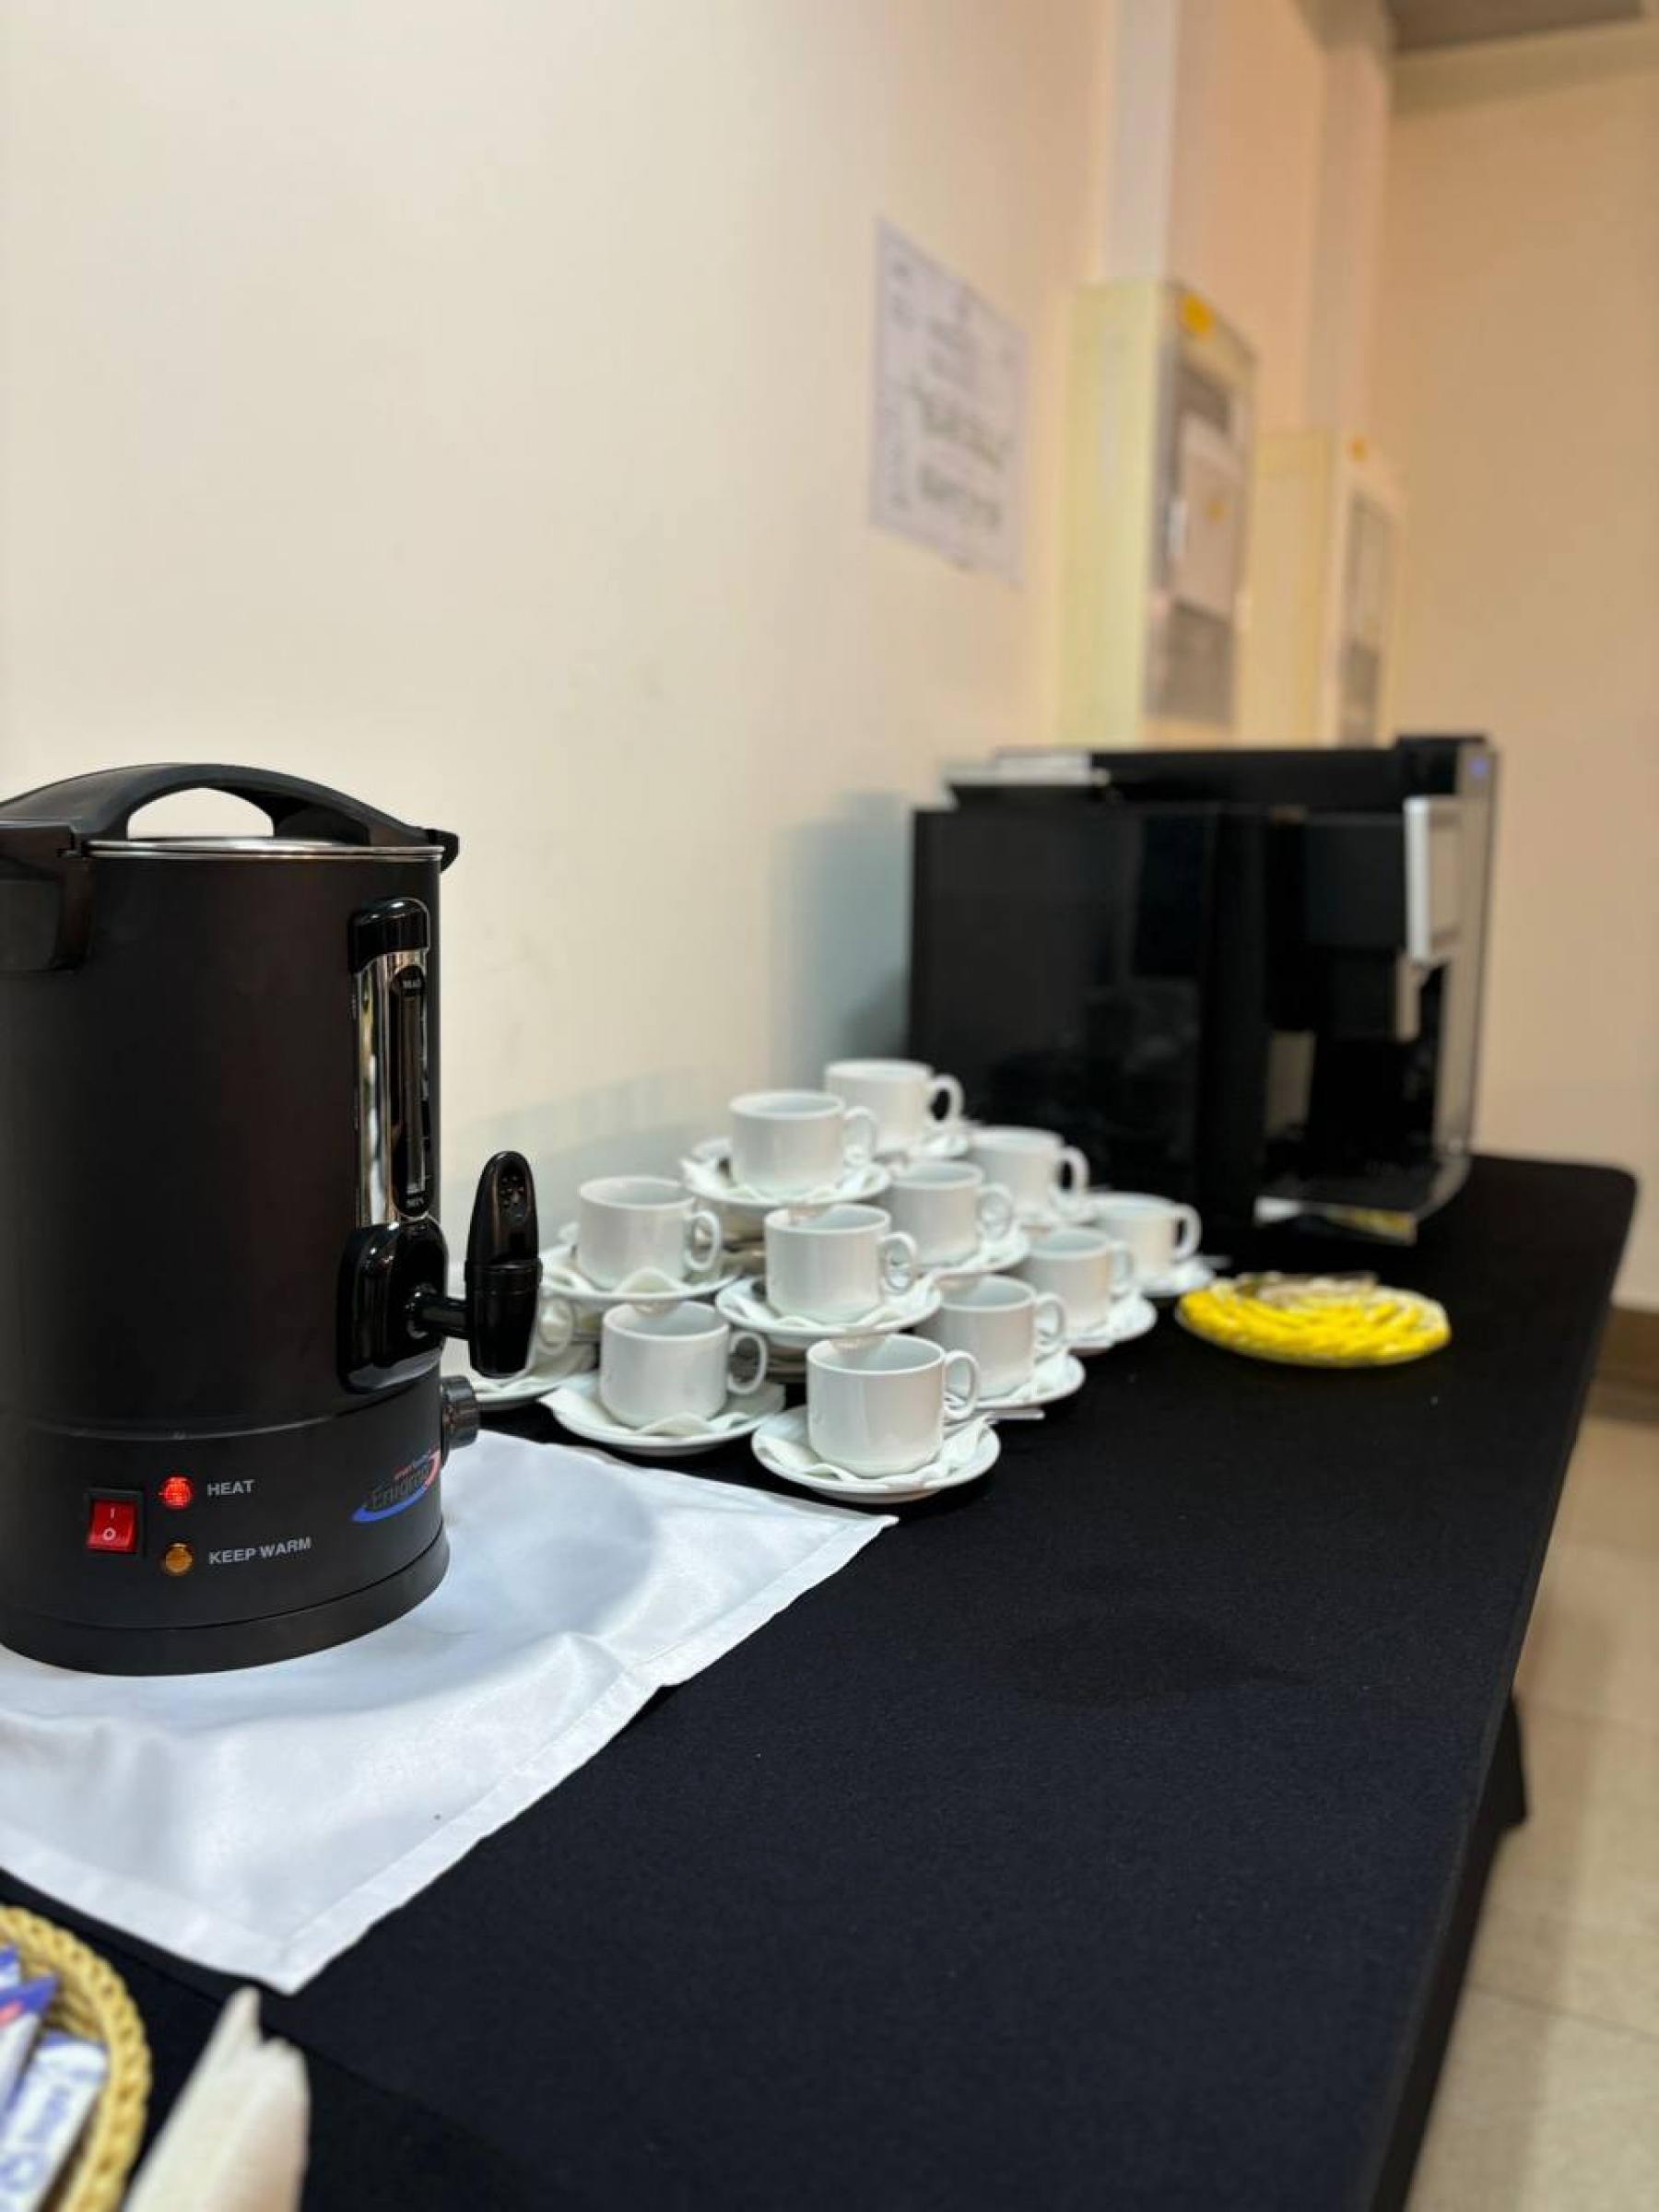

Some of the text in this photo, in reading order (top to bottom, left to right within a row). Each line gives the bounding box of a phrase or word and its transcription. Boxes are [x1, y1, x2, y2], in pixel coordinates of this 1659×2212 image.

[206, 1479, 255, 1496] HEAT
[208, 1535, 312, 1565] KEEP WARM
